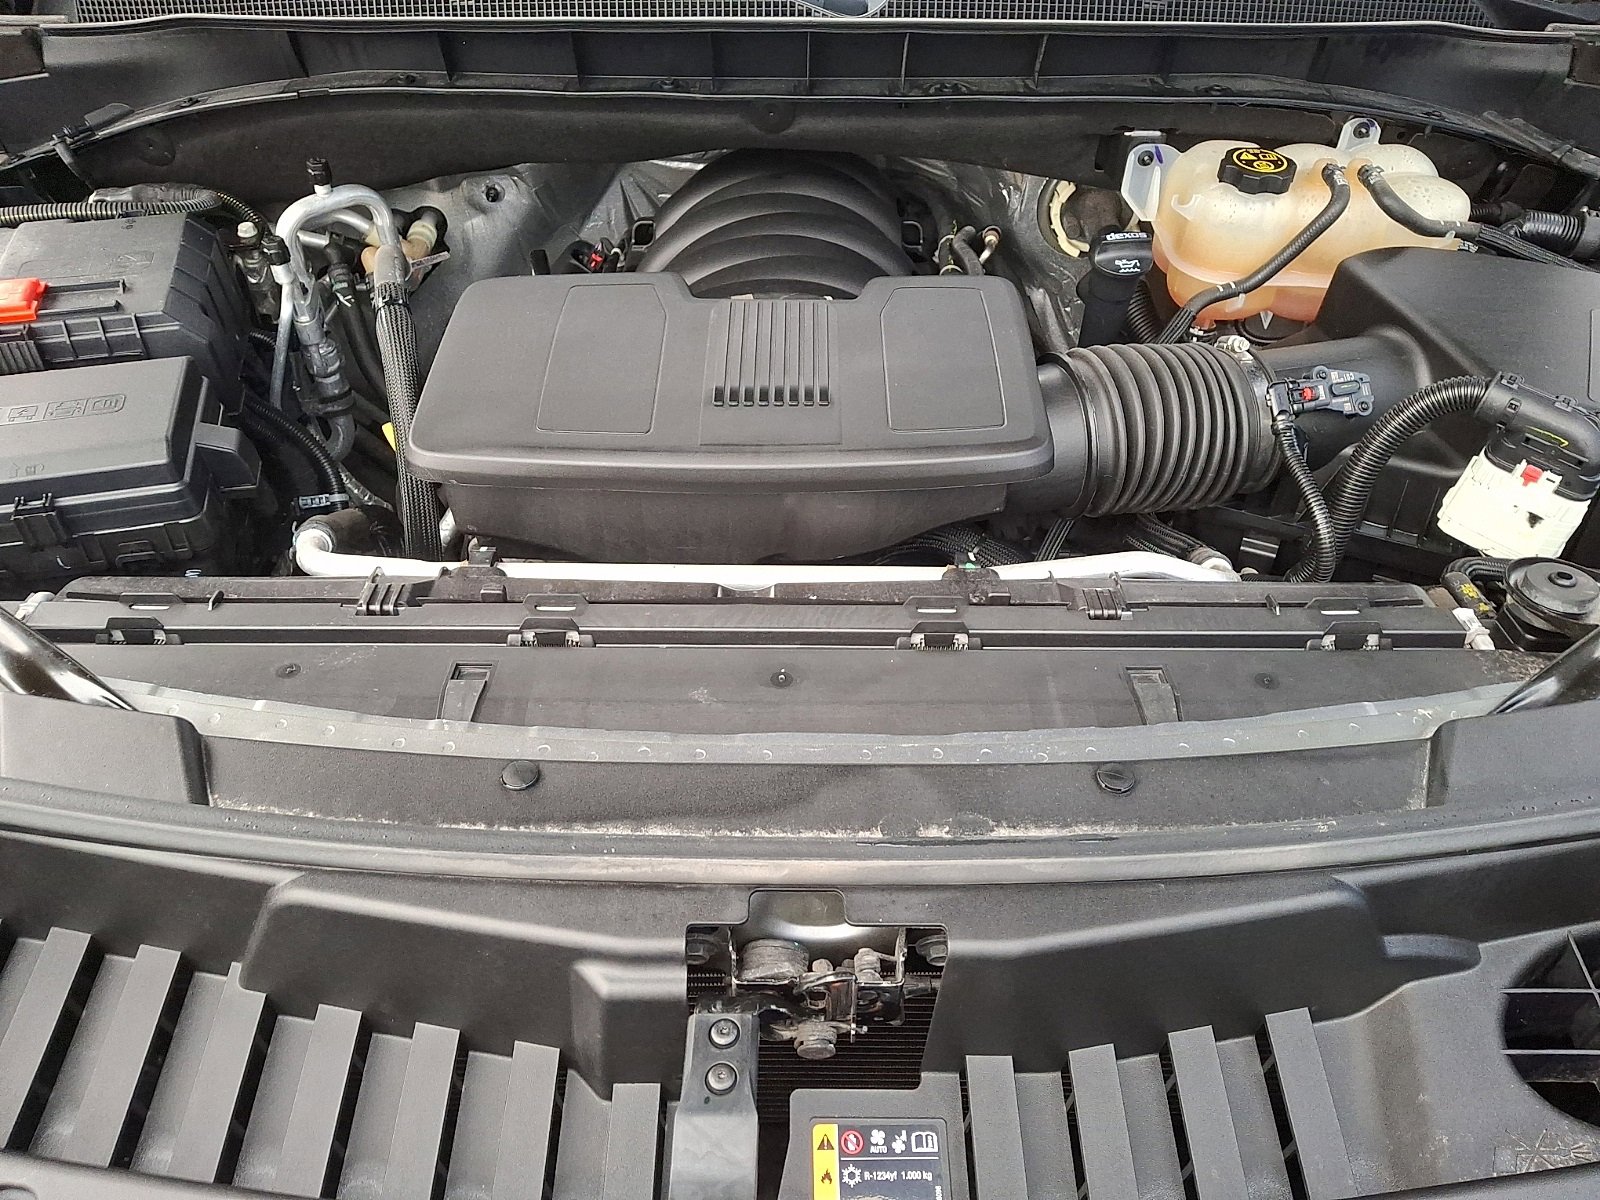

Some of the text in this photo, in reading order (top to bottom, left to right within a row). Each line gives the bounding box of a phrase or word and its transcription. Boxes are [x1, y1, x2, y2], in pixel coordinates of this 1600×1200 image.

[1106, 232, 1148, 241] dexos
[870, 1145, 887, 1153] AUTO
[864, 1170, 932, 1181] R-1234yf 1.000 kg
